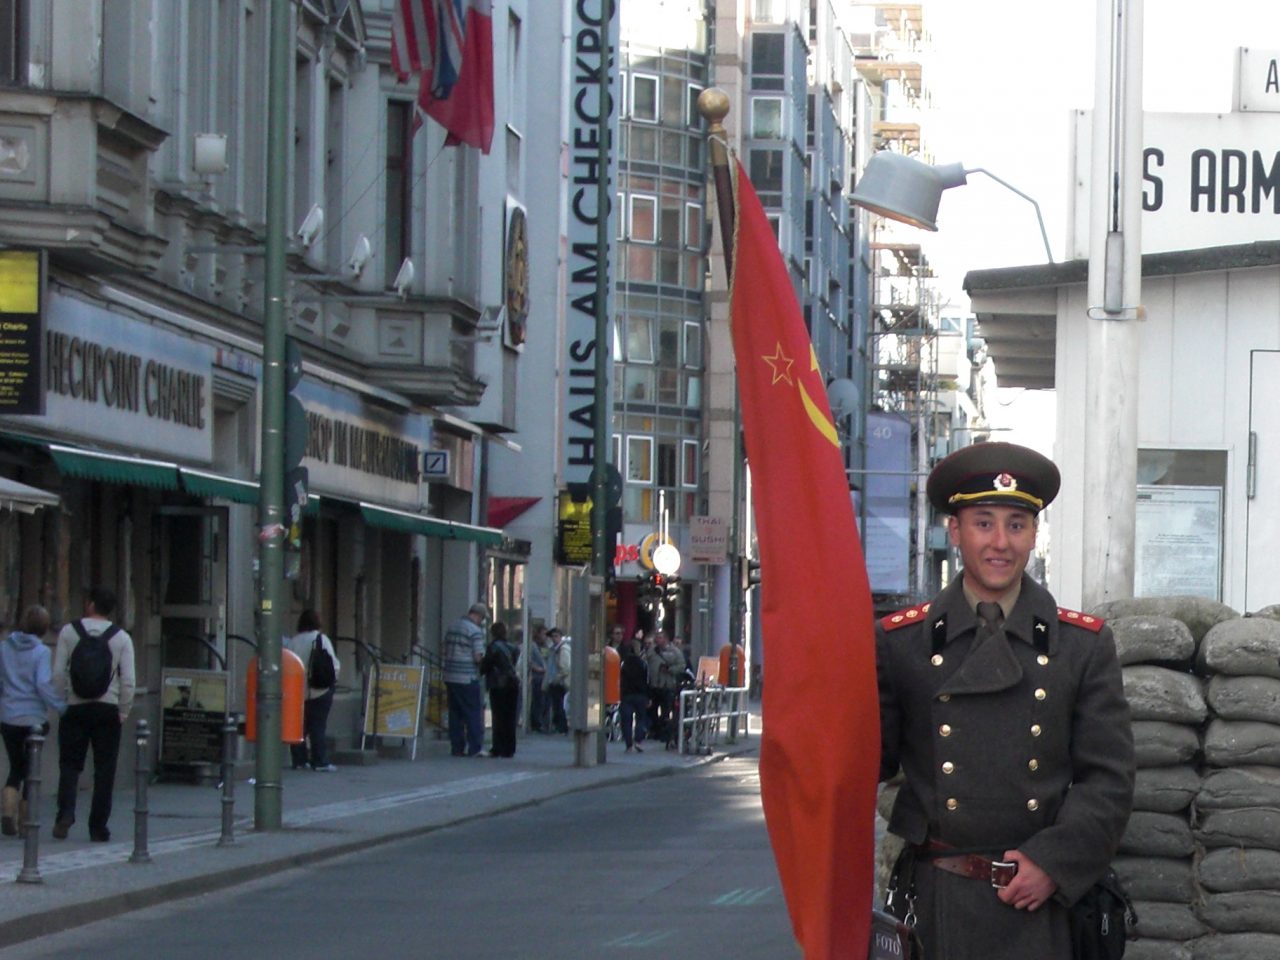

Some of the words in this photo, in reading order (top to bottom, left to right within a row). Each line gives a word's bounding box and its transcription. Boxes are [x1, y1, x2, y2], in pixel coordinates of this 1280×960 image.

[569, 241, 609, 320] AM
[144, 358, 206, 431] CHARLIE
[873, 427, 892, 438] 40
[875, 933, 900, 955] FOTO
